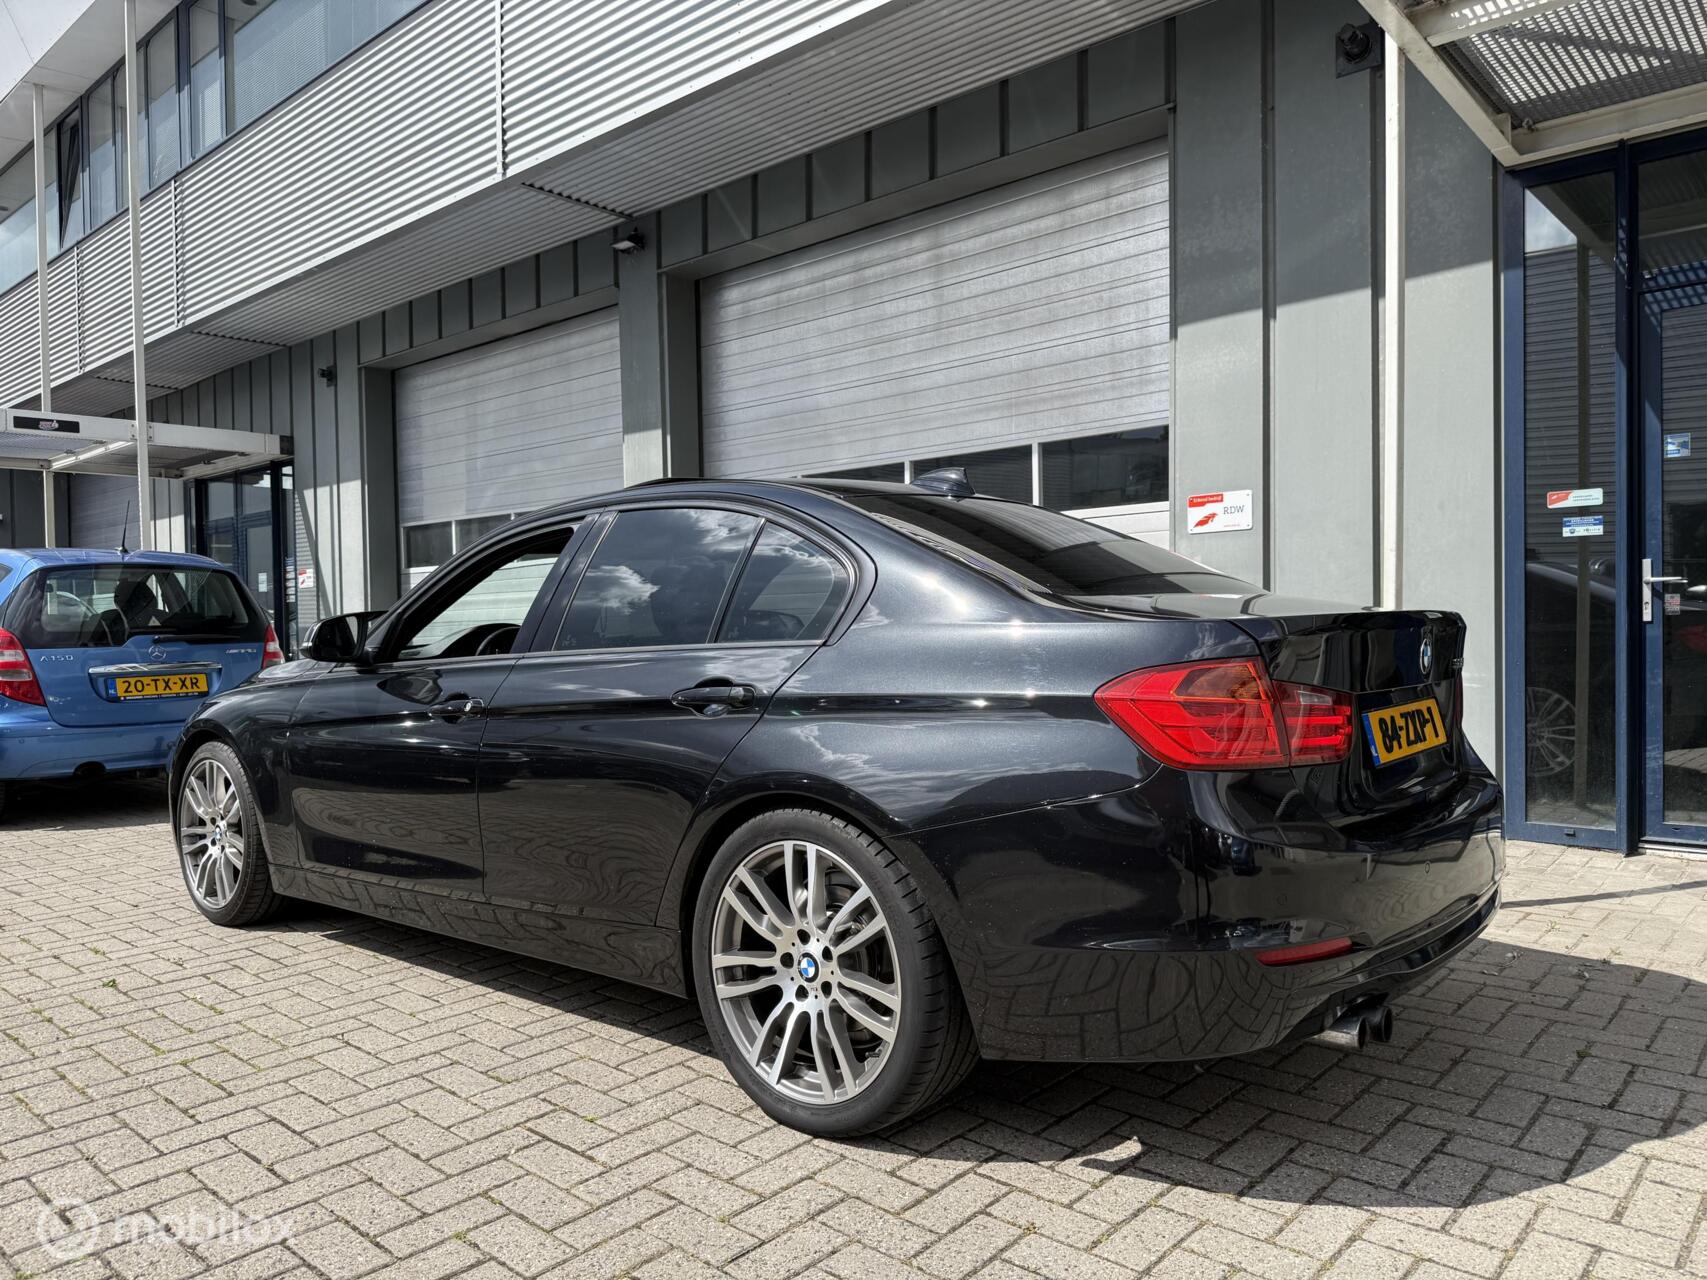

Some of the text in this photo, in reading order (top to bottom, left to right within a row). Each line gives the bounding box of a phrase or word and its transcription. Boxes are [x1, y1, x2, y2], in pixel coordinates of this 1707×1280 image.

[1223, 505, 1245, 515] RDW
[122, 676, 200, 694] 20-TX-XR
[1378, 706, 1440, 754] 84-ZXP-1
